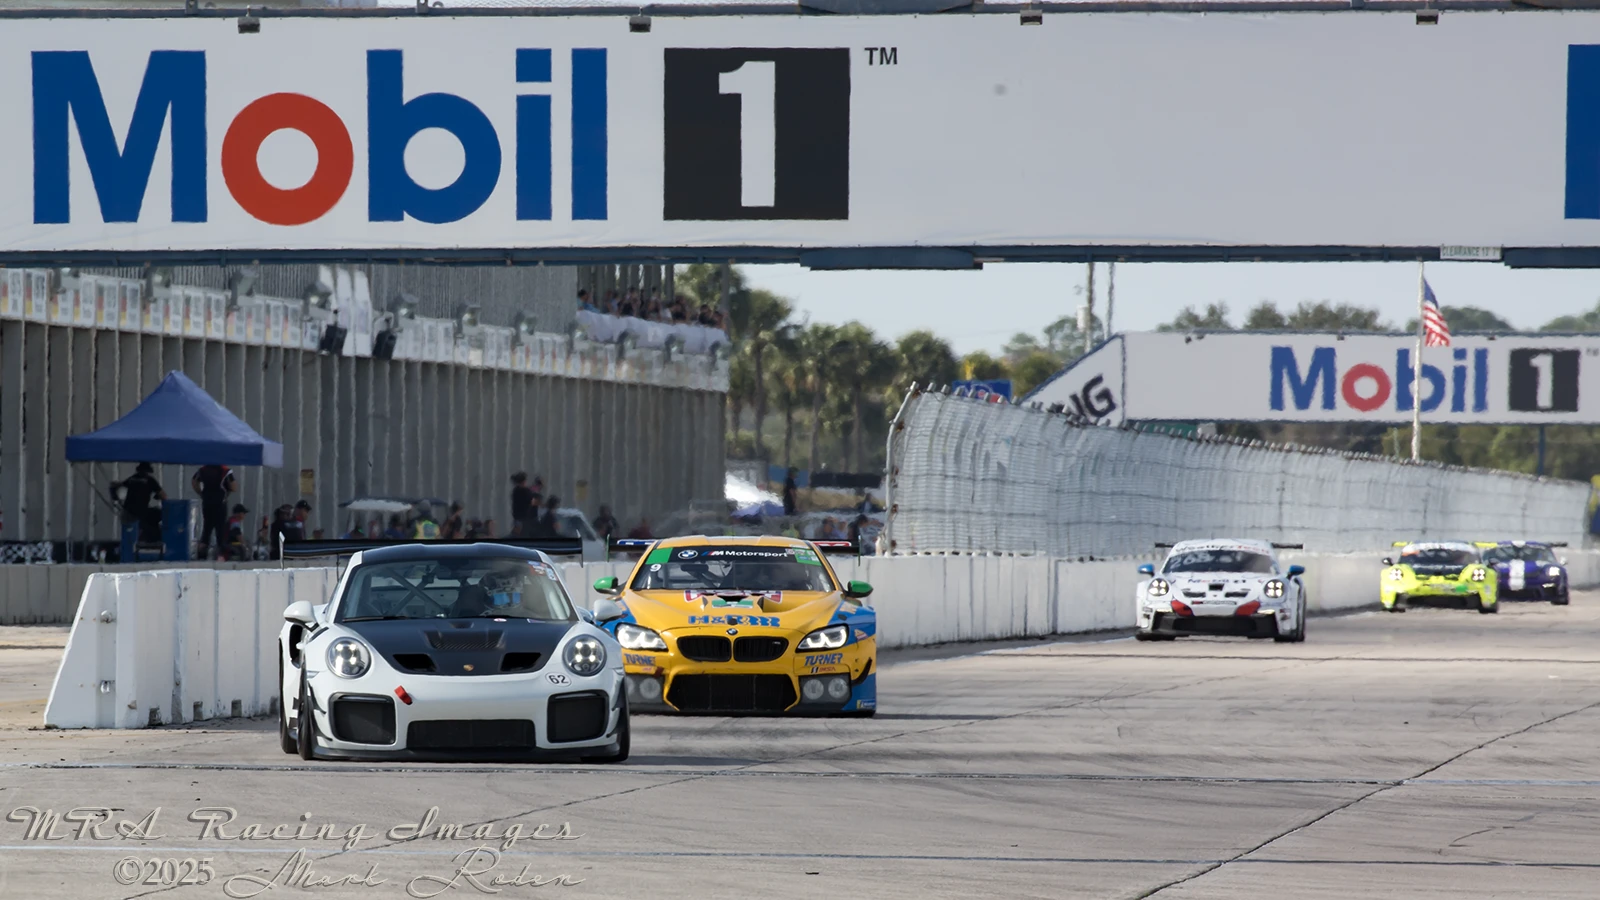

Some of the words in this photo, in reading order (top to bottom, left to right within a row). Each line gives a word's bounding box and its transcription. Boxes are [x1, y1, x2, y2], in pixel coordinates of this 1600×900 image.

[31, 47, 608, 226] Mobil
[864, 47, 898, 66] TM
[1269, 346, 1489, 413] Mobil
[725, 550, 788, 558] Motorsport
[650, 563, 662, 572] 9
[804, 652, 844, 667] TURNER
[548, 674, 570, 685] 62
